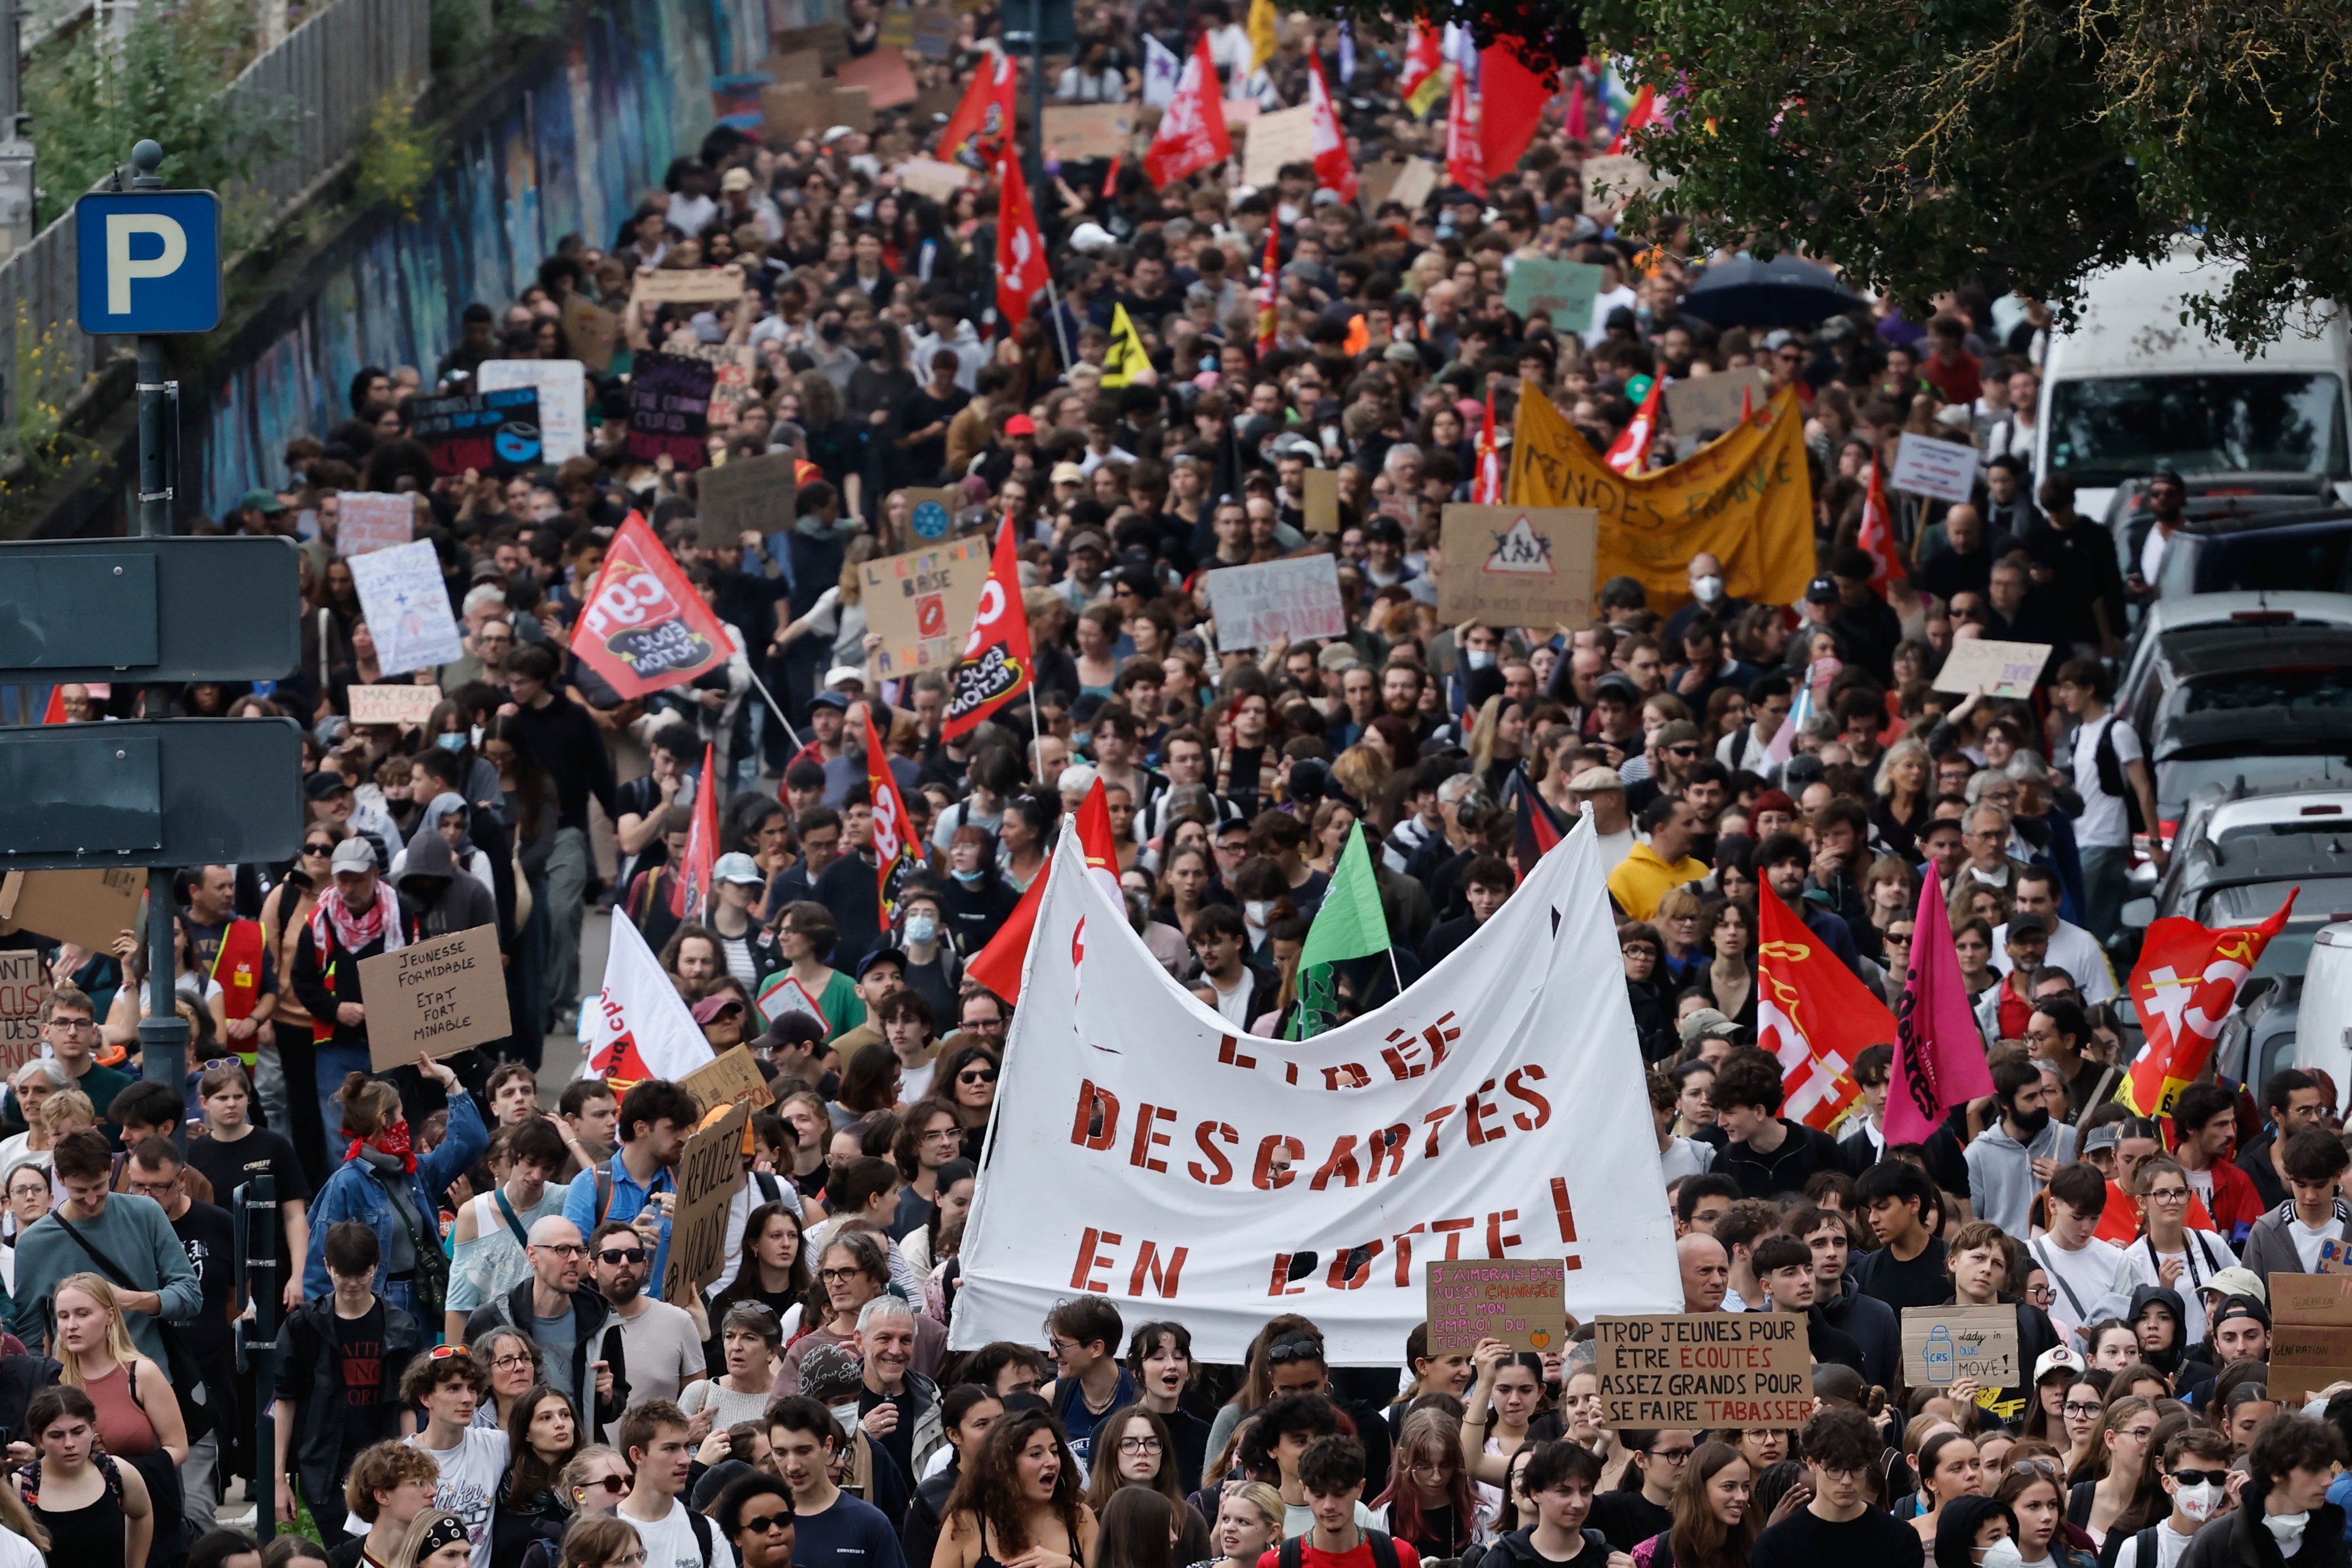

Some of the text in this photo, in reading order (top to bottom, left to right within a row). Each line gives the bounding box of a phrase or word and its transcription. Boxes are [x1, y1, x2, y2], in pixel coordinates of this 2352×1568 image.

[106, 214, 187, 314] P
[399, 940, 466, 969] JEUNESSE
[0, 957, 34, 980] NT
[398, 957, 475, 987] FORMIDABLE
[417, 987, 456, 1008] ETAT
[424, 1002, 457, 1021] FORT
[1071, 1064, 1551, 1190] DESCARTES
[683, 1126, 743, 1209] RÉVOLTEZ
[1070, 1226, 1189, 1298] EN
[1529, 1263, 1564, 1282] ÊTRE
[1434, 1280, 1558, 1299] AUSSI CHARGÉE
[1434, 1302, 1506, 1316] QUE MON
[1505, 1319, 1526, 1331] DU
[1597, 1320, 1795, 1343] TROP JEUNES POUR
[1958, 1328, 2001, 1346] Lady in
[1616, 1344, 1772, 1369] ÊTRE ÉCOUTÉS
[2274, 1342, 2328, 1356] GÉNÉRATION
[1600, 1373, 1803, 1396] ASSEZ GRANDS POUR
[1609, 1400, 1813, 1422] SE FAIRE TABASSER
